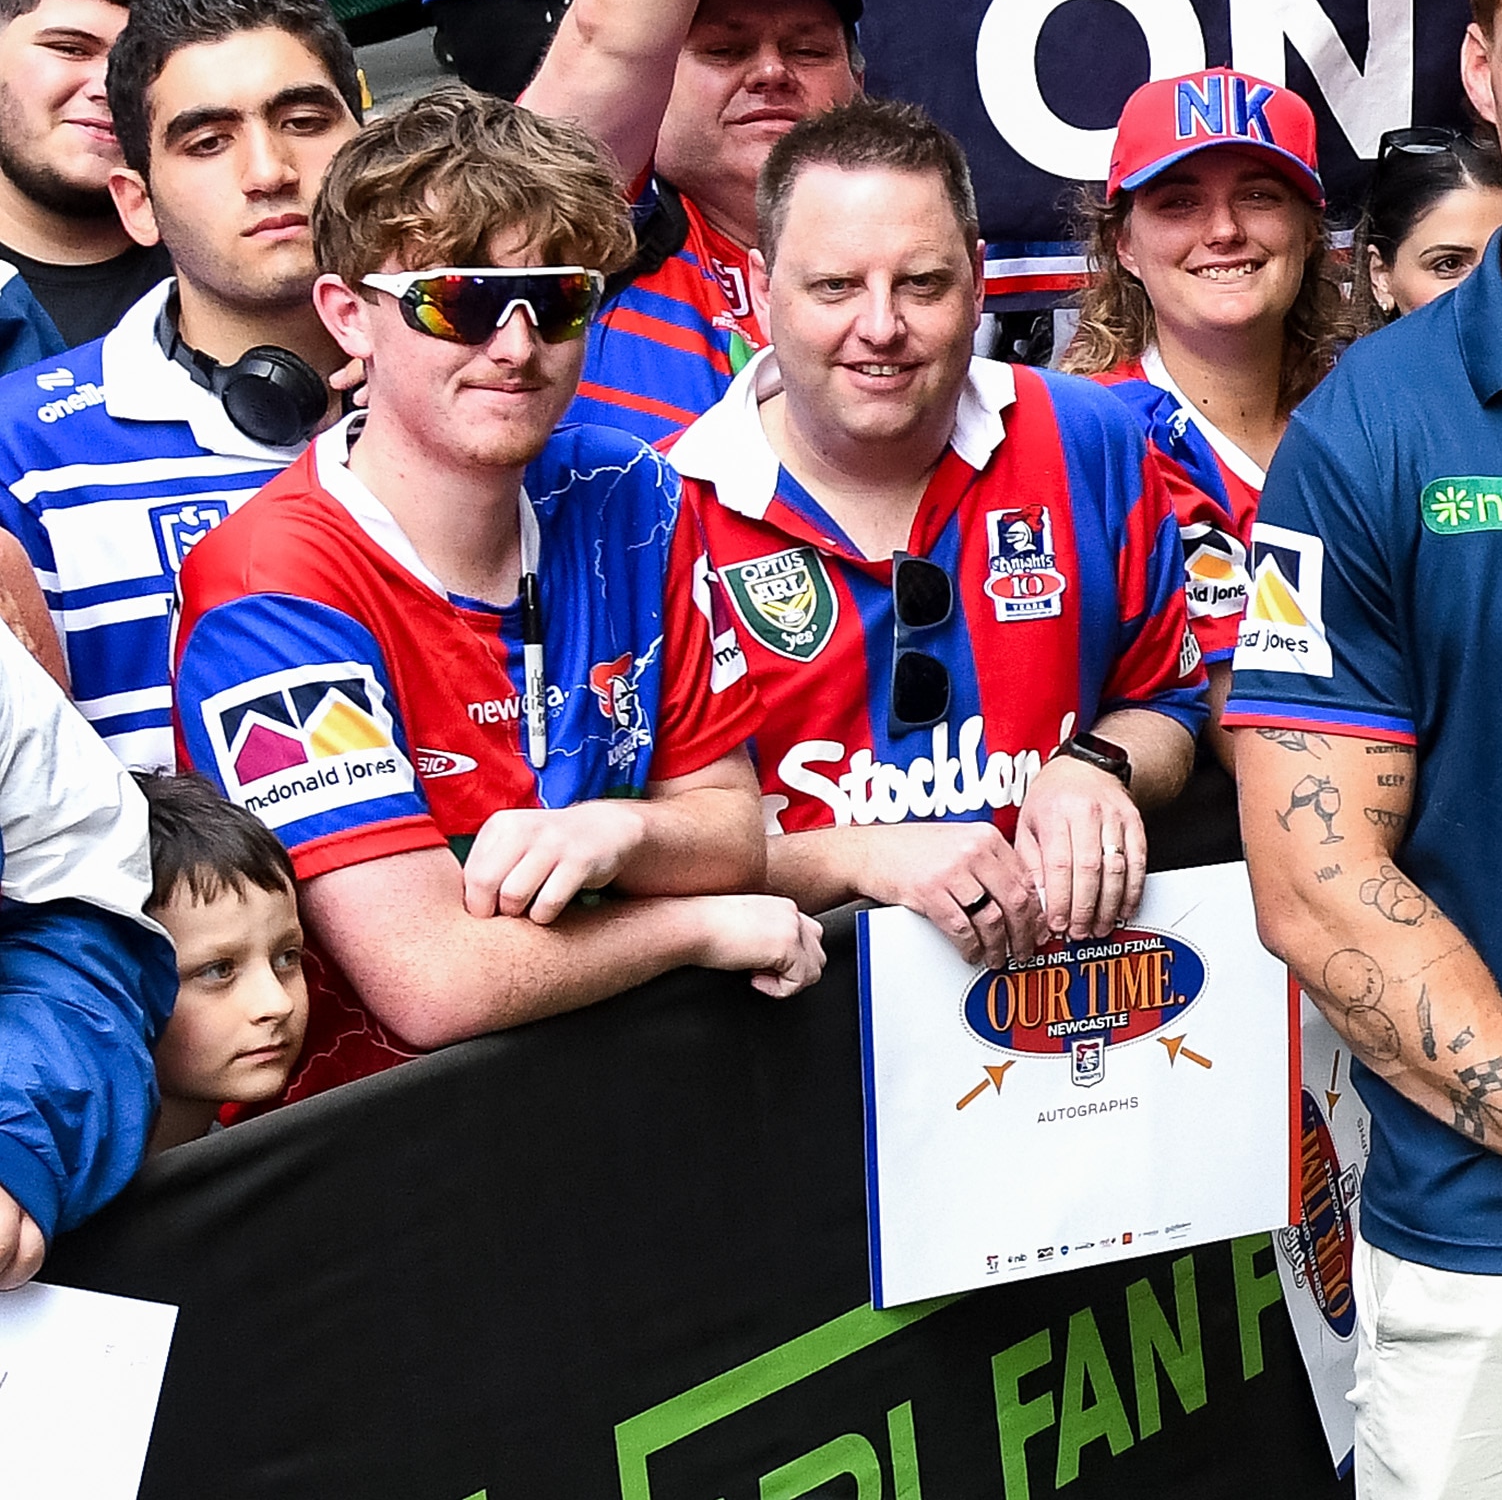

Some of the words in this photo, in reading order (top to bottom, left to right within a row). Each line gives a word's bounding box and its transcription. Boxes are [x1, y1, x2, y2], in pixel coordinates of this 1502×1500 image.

[1174, 73, 1277, 148] NK
[740, 551, 806, 583] OPTUS
[1010, 574, 1045, 598] 10
[1210, 583, 1247, 606] jone
[245, 766, 341, 813] mcdonald
[346, 755, 397, 787] jones
[1316, 863, 1343, 884] HIM
[1047, 950, 1075, 965] NRL
[1076, 942, 1123, 962] GRAND
[1124, 937, 1166, 954] FINAL
[985, 965, 1074, 1033] OUR
[1079, 950, 1187, 1019] TIME.
[1047, 1012, 1129, 1038] NEWCASTLE
[1036, 1096, 1140, 1124] AUTOGRAPHS
[1323, 1158, 1348, 1243] NEWCASTLE
[1312, 1227, 1352, 1320] OUR
[990, 1252, 1208, 1499] FAN
